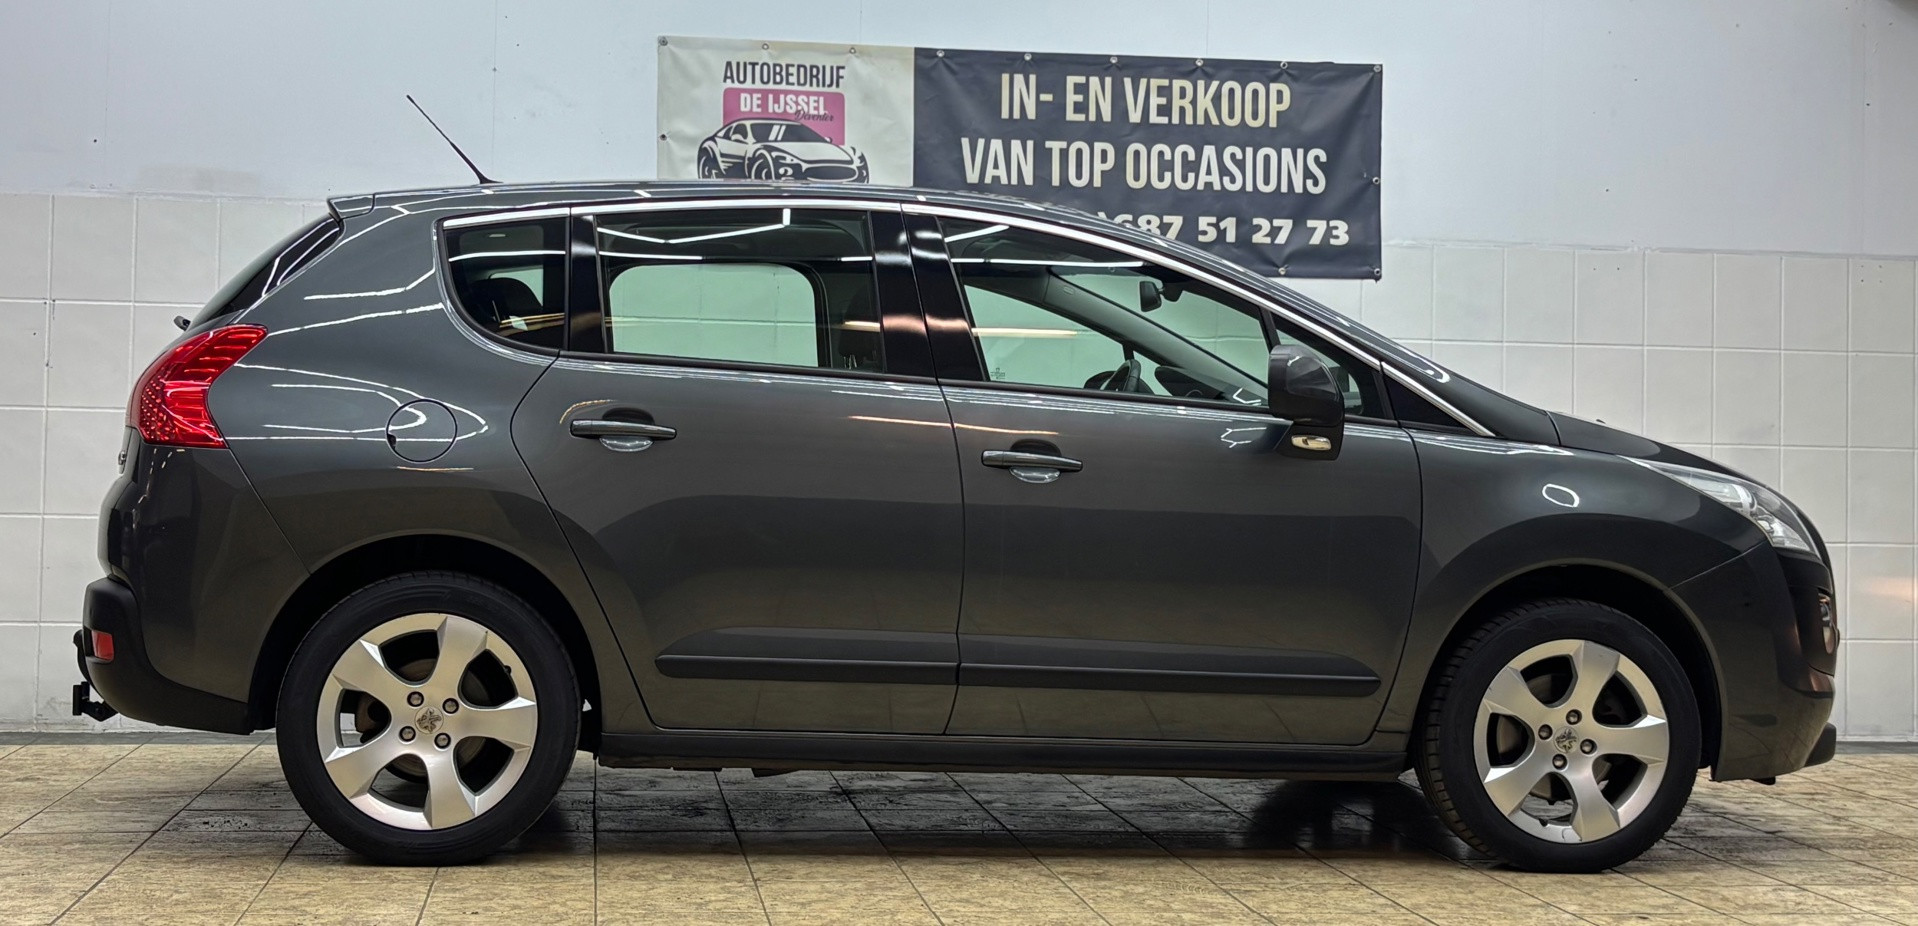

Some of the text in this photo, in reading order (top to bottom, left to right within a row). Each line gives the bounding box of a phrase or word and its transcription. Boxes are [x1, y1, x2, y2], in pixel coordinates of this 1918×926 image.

[723, 61, 845, 88] AUTOBEDRIJF
[740, 93, 827, 115] DE IJSSEL
[1001, 73, 1291, 128] IN- EN VERKOOP
[795, 110, 834, 122] Deventer
[961, 137, 1328, 195] VAN TOP OCCASIONS
[1198, 216, 1237, 243] 51
[1252, 217, 1293, 245] 27
[1306, 219, 1349, 246] 73
